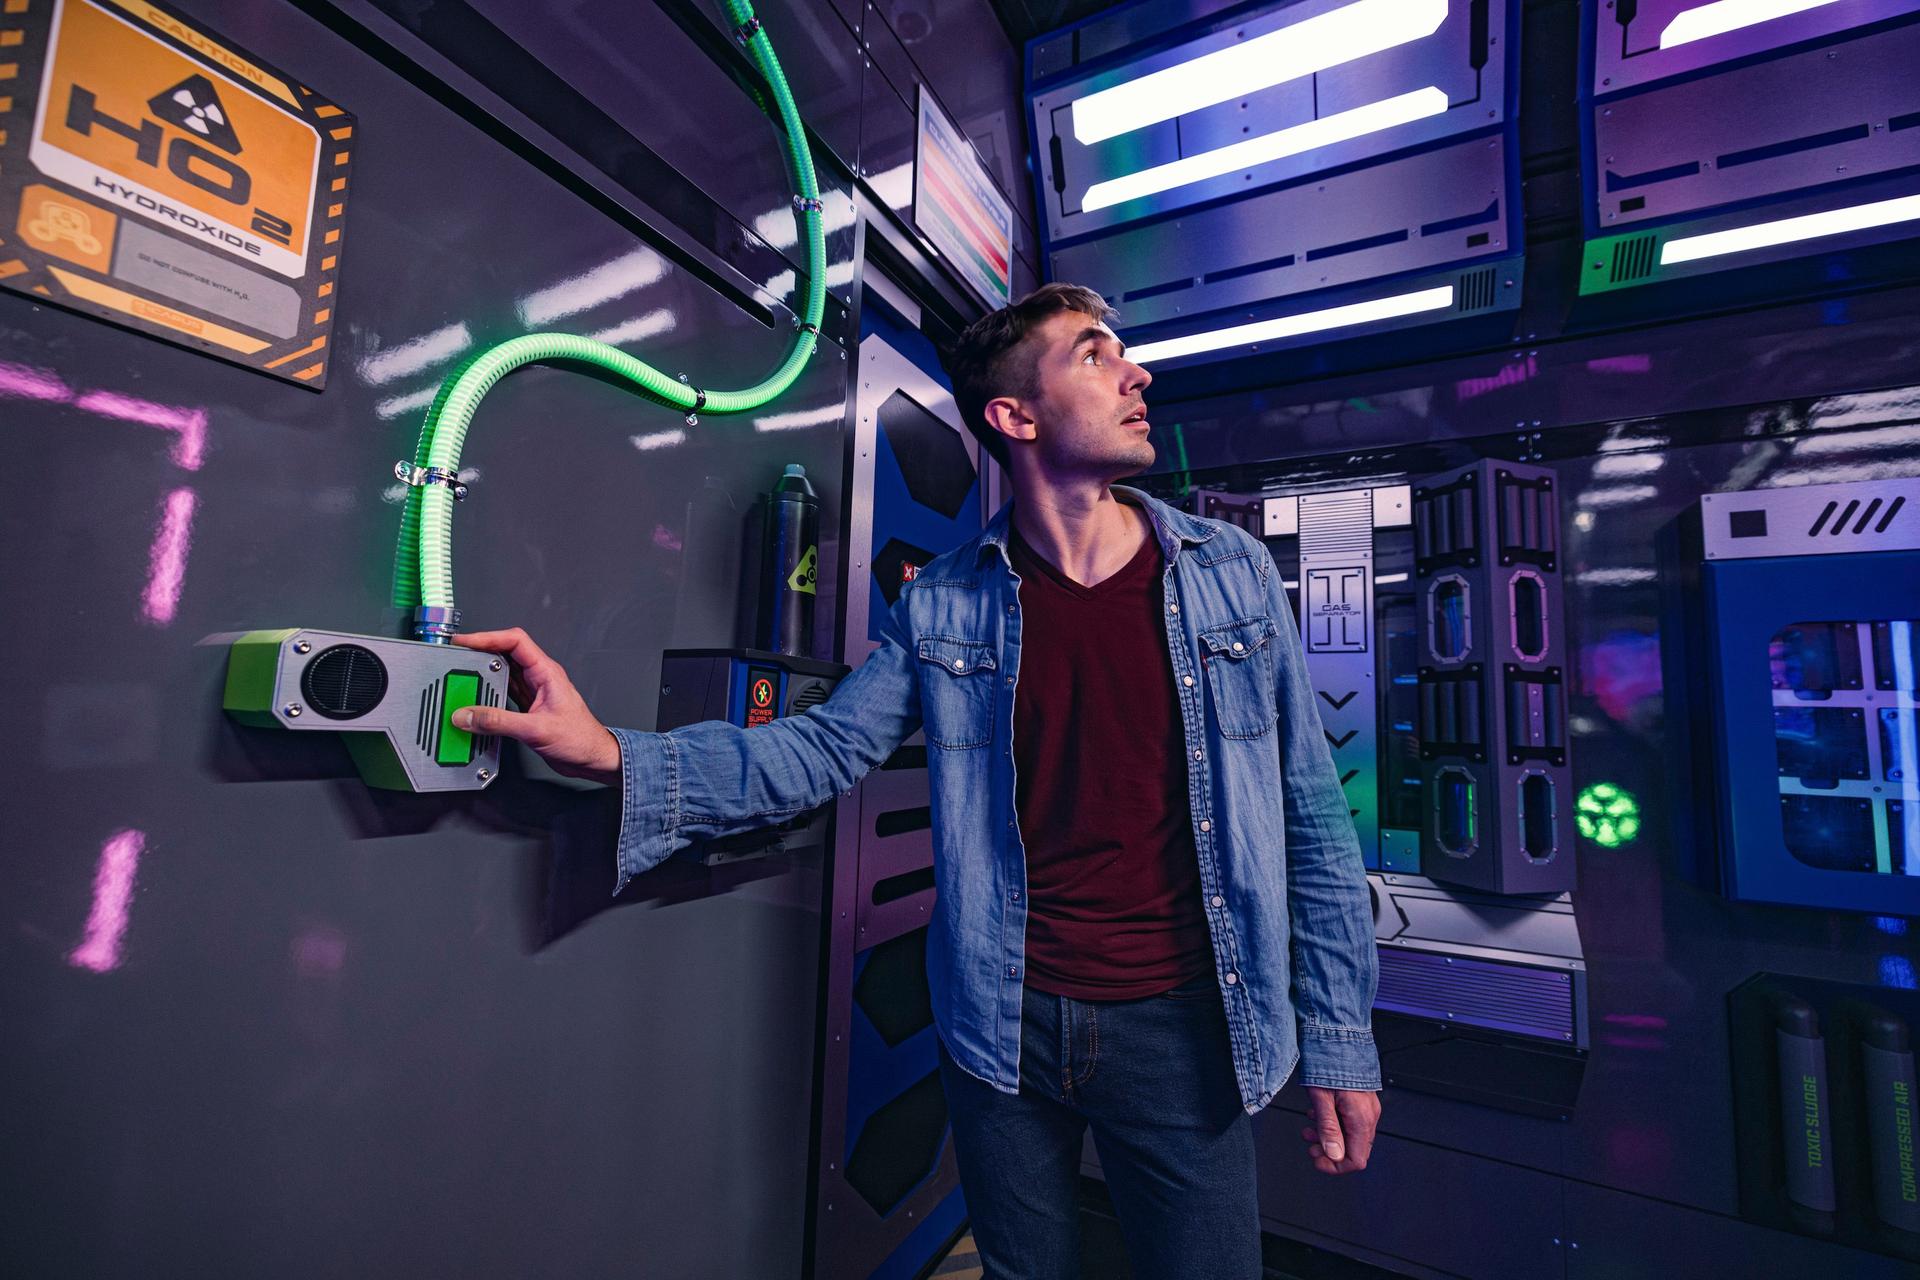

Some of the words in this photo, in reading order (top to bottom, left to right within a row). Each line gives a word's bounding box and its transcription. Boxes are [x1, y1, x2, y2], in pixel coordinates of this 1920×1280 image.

[148, 10, 263, 82] CAUTION
[94, 176, 261, 256] HYDROXIDE
[211, 281, 232, 294] WITH
[1803, 1075, 1819, 1127] SLUDGE
[1893, 1080, 1910, 1105] AIR
[1806, 1129, 1823, 1168] TOXIC
[1895, 1107, 1917, 1202] COMPRESSED
